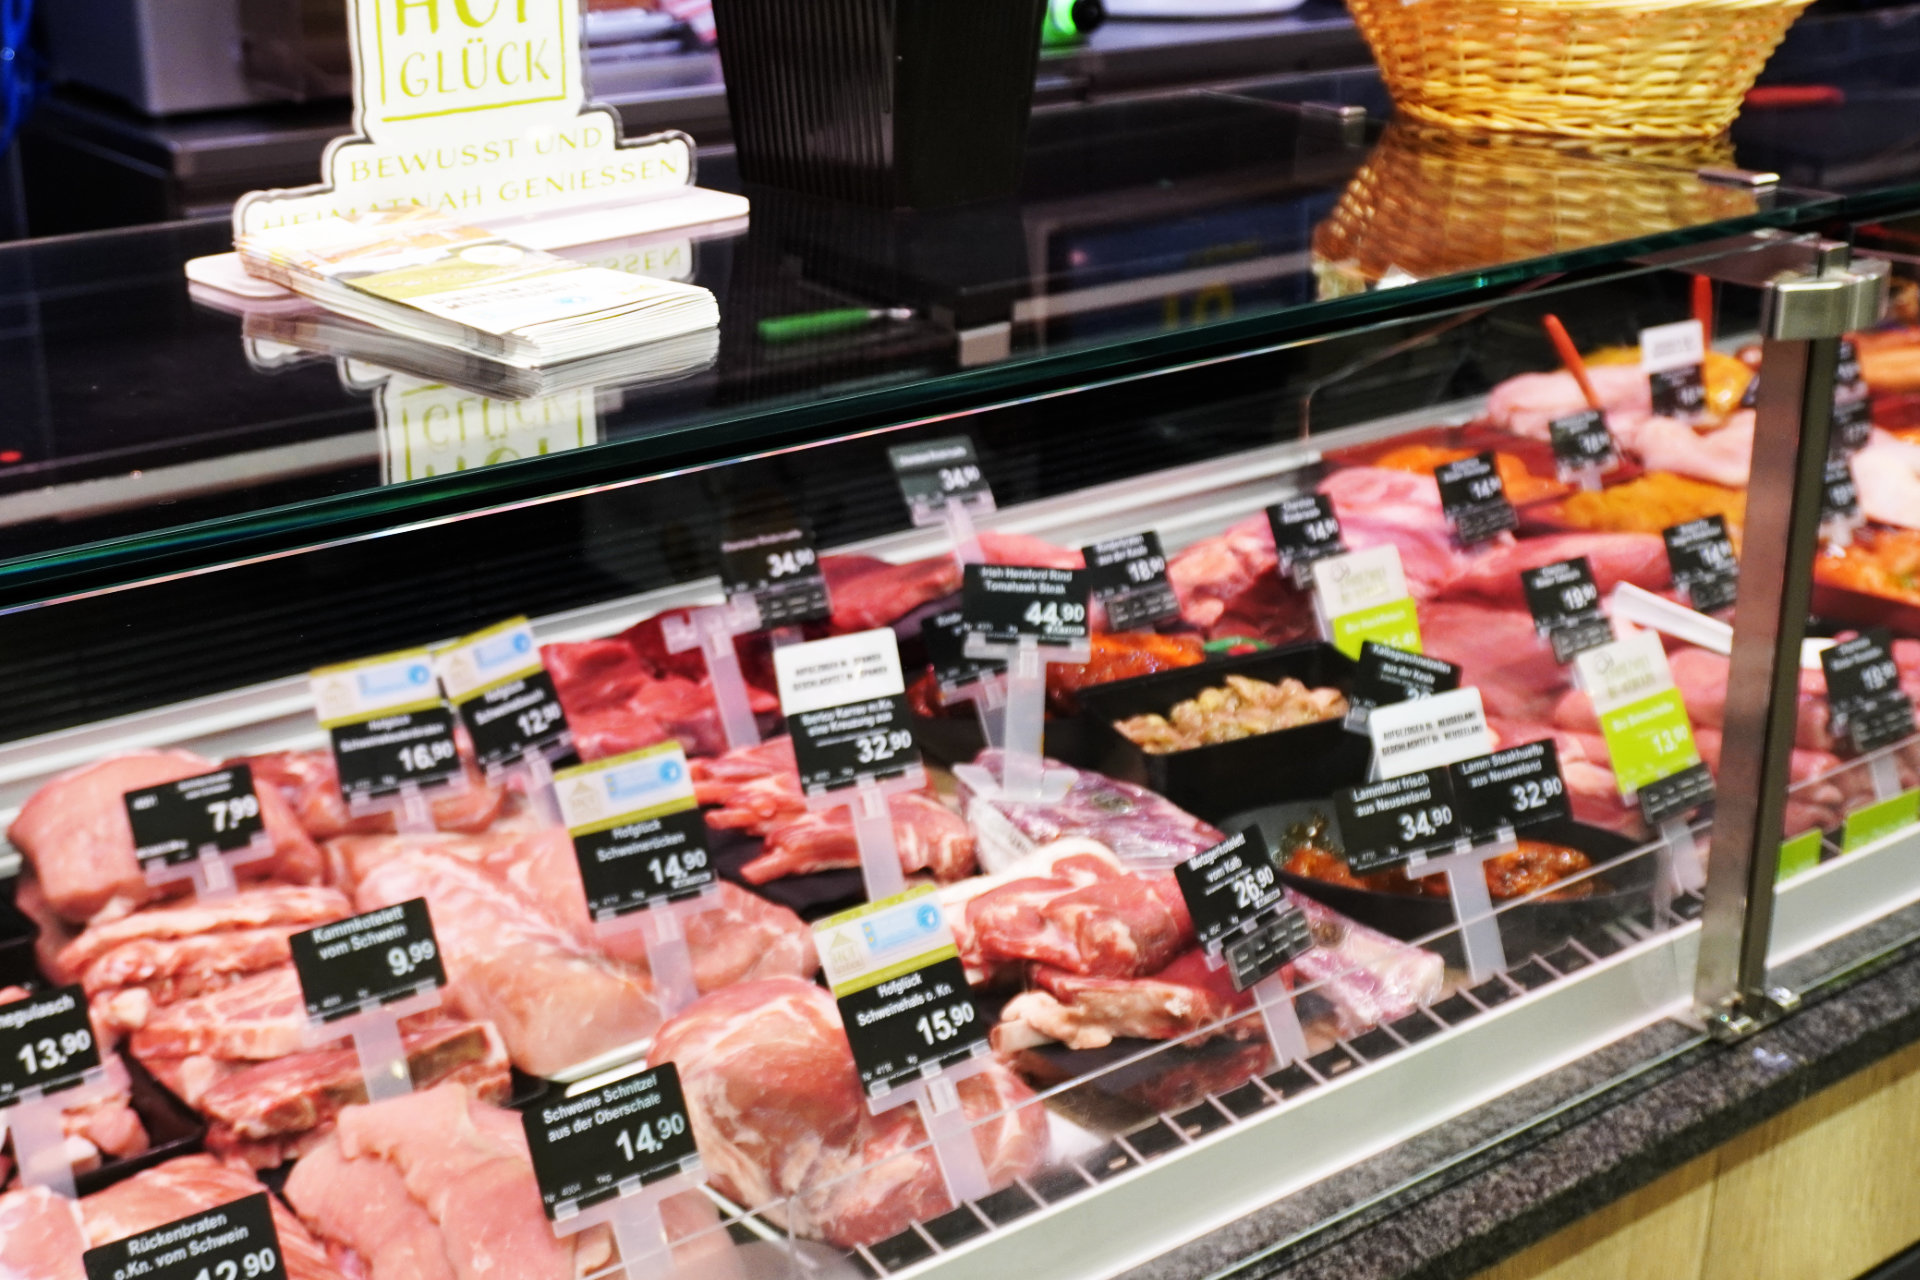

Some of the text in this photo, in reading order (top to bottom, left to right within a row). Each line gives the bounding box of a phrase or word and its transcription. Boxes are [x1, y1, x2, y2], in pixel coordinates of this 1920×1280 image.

[400, 37, 550, 97] GLÜCK
[350, 126, 603, 183] BEWUSST UND
[499, 149, 679, 201] GENIESSEN
[981, 567, 1073, 582] Irish Hereford Rind
[984, 579, 1037, 592] Tomahawk
[1024, 601, 1085, 626] 44.90
[398, 739, 455, 772] 16.90
[855, 729, 912, 763] 32.90
[1402, 773, 1430, 792] frisch
[1462, 759, 1490, 775] Lamm
[1471, 759, 1542, 788] aus Neuseeland
[1356, 788, 1432, 817] aus Neuseeland
[1512, 777, 1563, 811] 32.90
[1400, 805, 1453, 842] 34.90
[648, 848, 707, 884] 14.90
[1234, 865, 1274, 909] 26.90
[319, 923, 408, 960] vom Schwein
[387, 939, 436, 976] 9.99
[877, 972, 922, 998] Hofglück
[856, 993, 924, 1027] Schweinehals
[917, 1002, 975, 1045] 15.90
[18, 1029, 92, 1075] 13.90
[542, 1073, 658, 1124] Schweine Schnitzel
[547, 1092, 662, 1143] aus der Oberschale
[615, 1112, 685, 1162] 14.90
[127, 1213, 228, 1257] Rückenbraten
[155, 1247, 187, 1269] vom
[188, 1226, 249, 1257] Schwein
